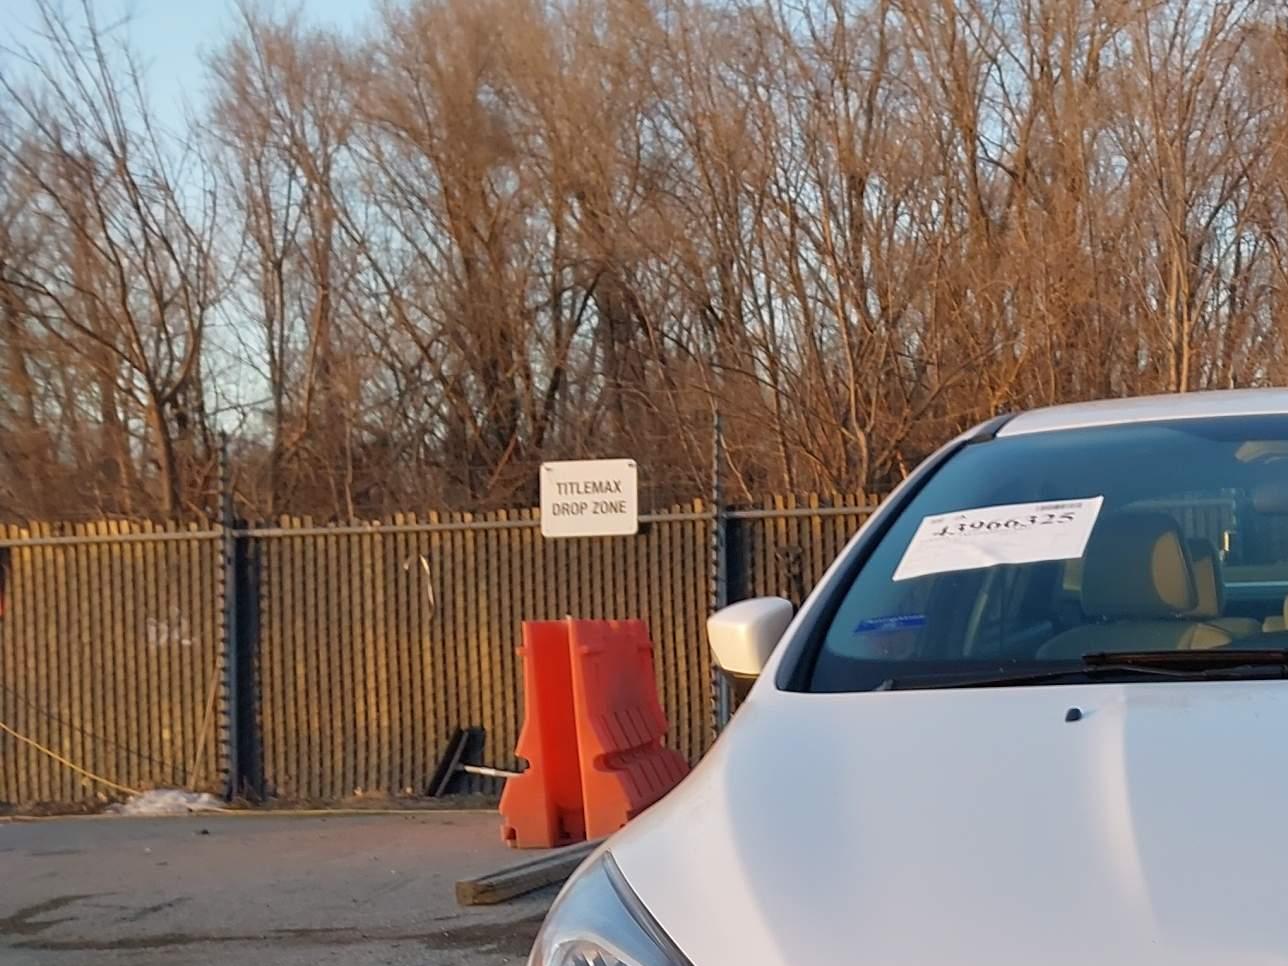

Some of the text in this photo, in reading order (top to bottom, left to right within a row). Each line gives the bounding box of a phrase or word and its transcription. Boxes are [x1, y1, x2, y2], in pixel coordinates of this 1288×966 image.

[556, 480, 622, 496] TITLEMAX
[552, 500, 627, 516] DROP ZONE
